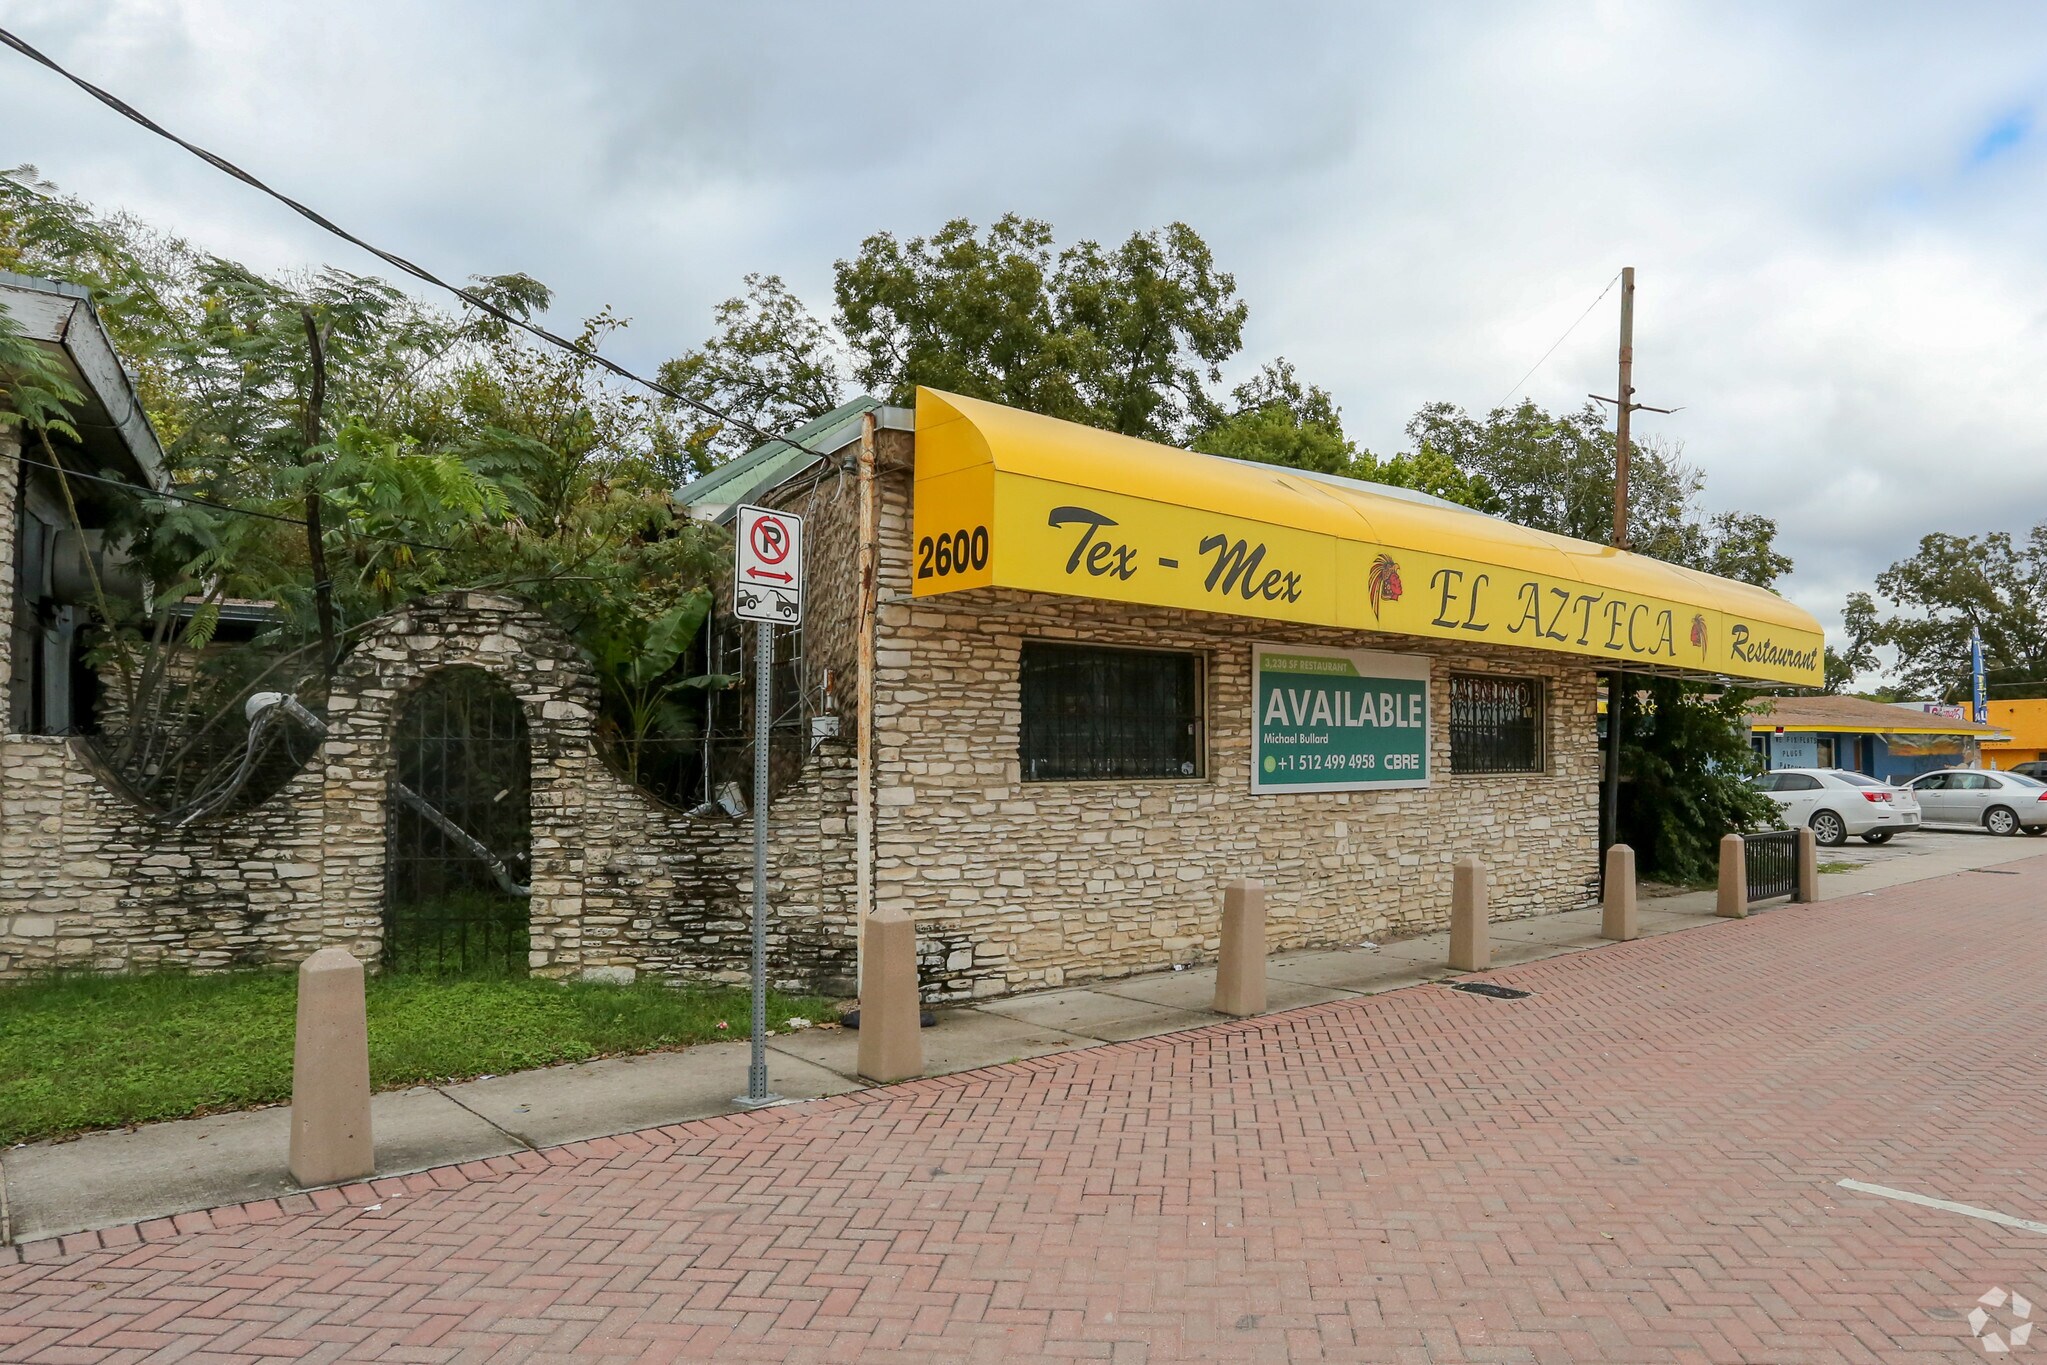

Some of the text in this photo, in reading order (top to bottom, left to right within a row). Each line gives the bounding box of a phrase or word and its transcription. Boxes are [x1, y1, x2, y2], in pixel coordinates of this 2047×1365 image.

[918, 525, 988, 579] 2600
[1048, 506, 1137, 581] Tex
[1199, 534, 1301, 603] Mex
[1430, 569, 1818, 672] EL AZTECA Restaurant
[1265, 658, 1347, 672] 3,230 SF RESTAURANT
[1263, 688, 1422, 728] AVAILABLE
[1263, 733, 1328, 744] Michael Bullard
[1786, 736, 1797, 744] FIX
[1800, 736, 1817, 745] FLATS
[1278, 754, 1375, 770] +1 512 499 4958
[1384, 754, 1419, 769] CBRE
